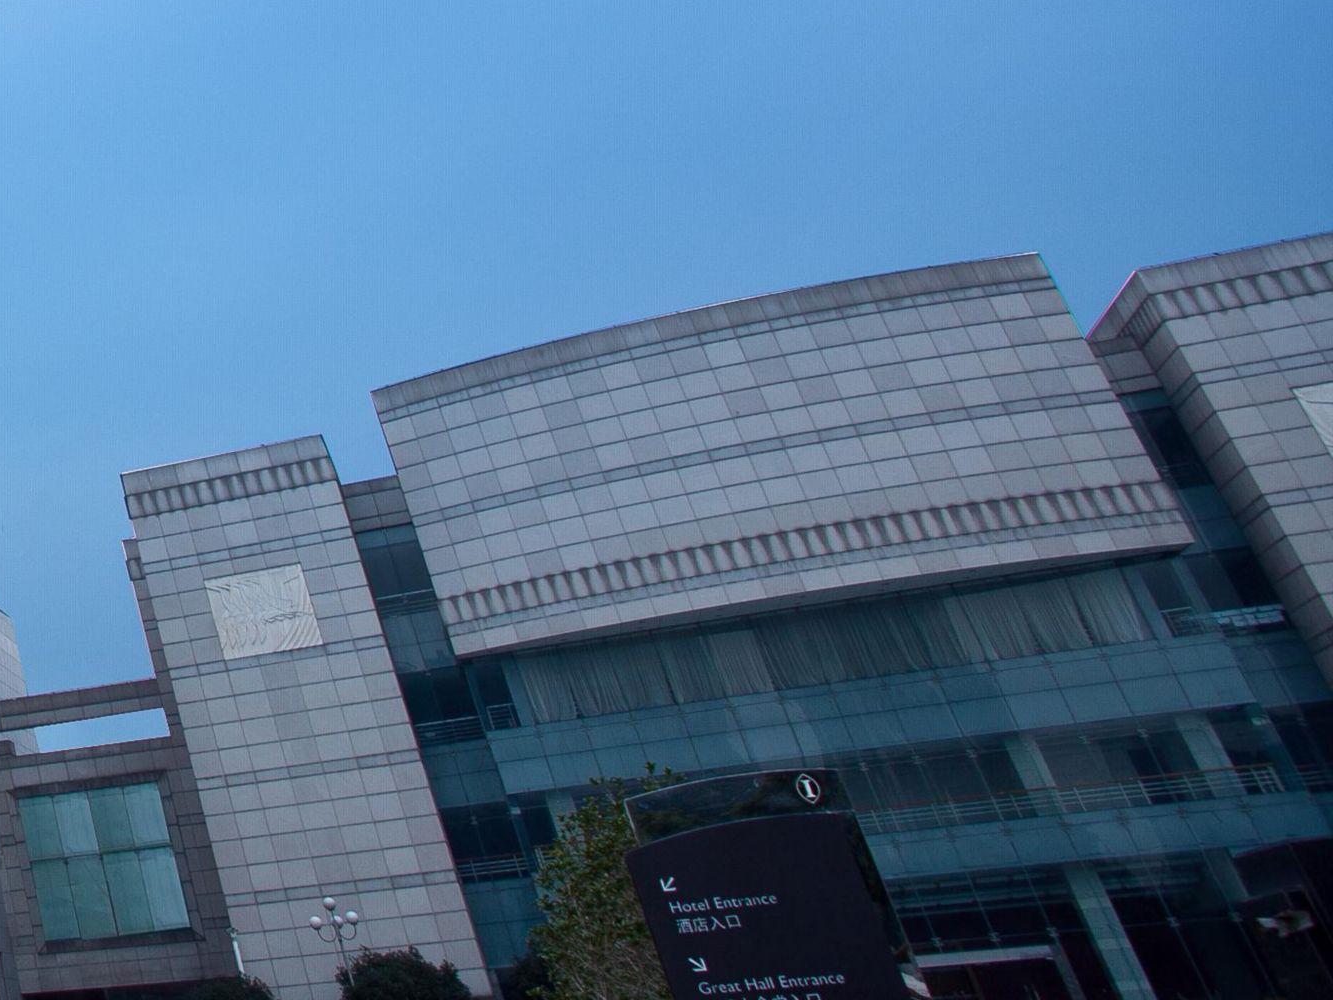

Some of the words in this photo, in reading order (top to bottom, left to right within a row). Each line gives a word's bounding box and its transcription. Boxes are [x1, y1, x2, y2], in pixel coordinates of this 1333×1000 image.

[669, 899, 710, 913] Hotel
[714, 895, 778, 910] Entrance
[677, 914, 741, 933] 酒店入口
[698, 981, 742, 995] Great
[744, 976, 775, 991] Hall
[778, 974, 845, 988] Entrance
